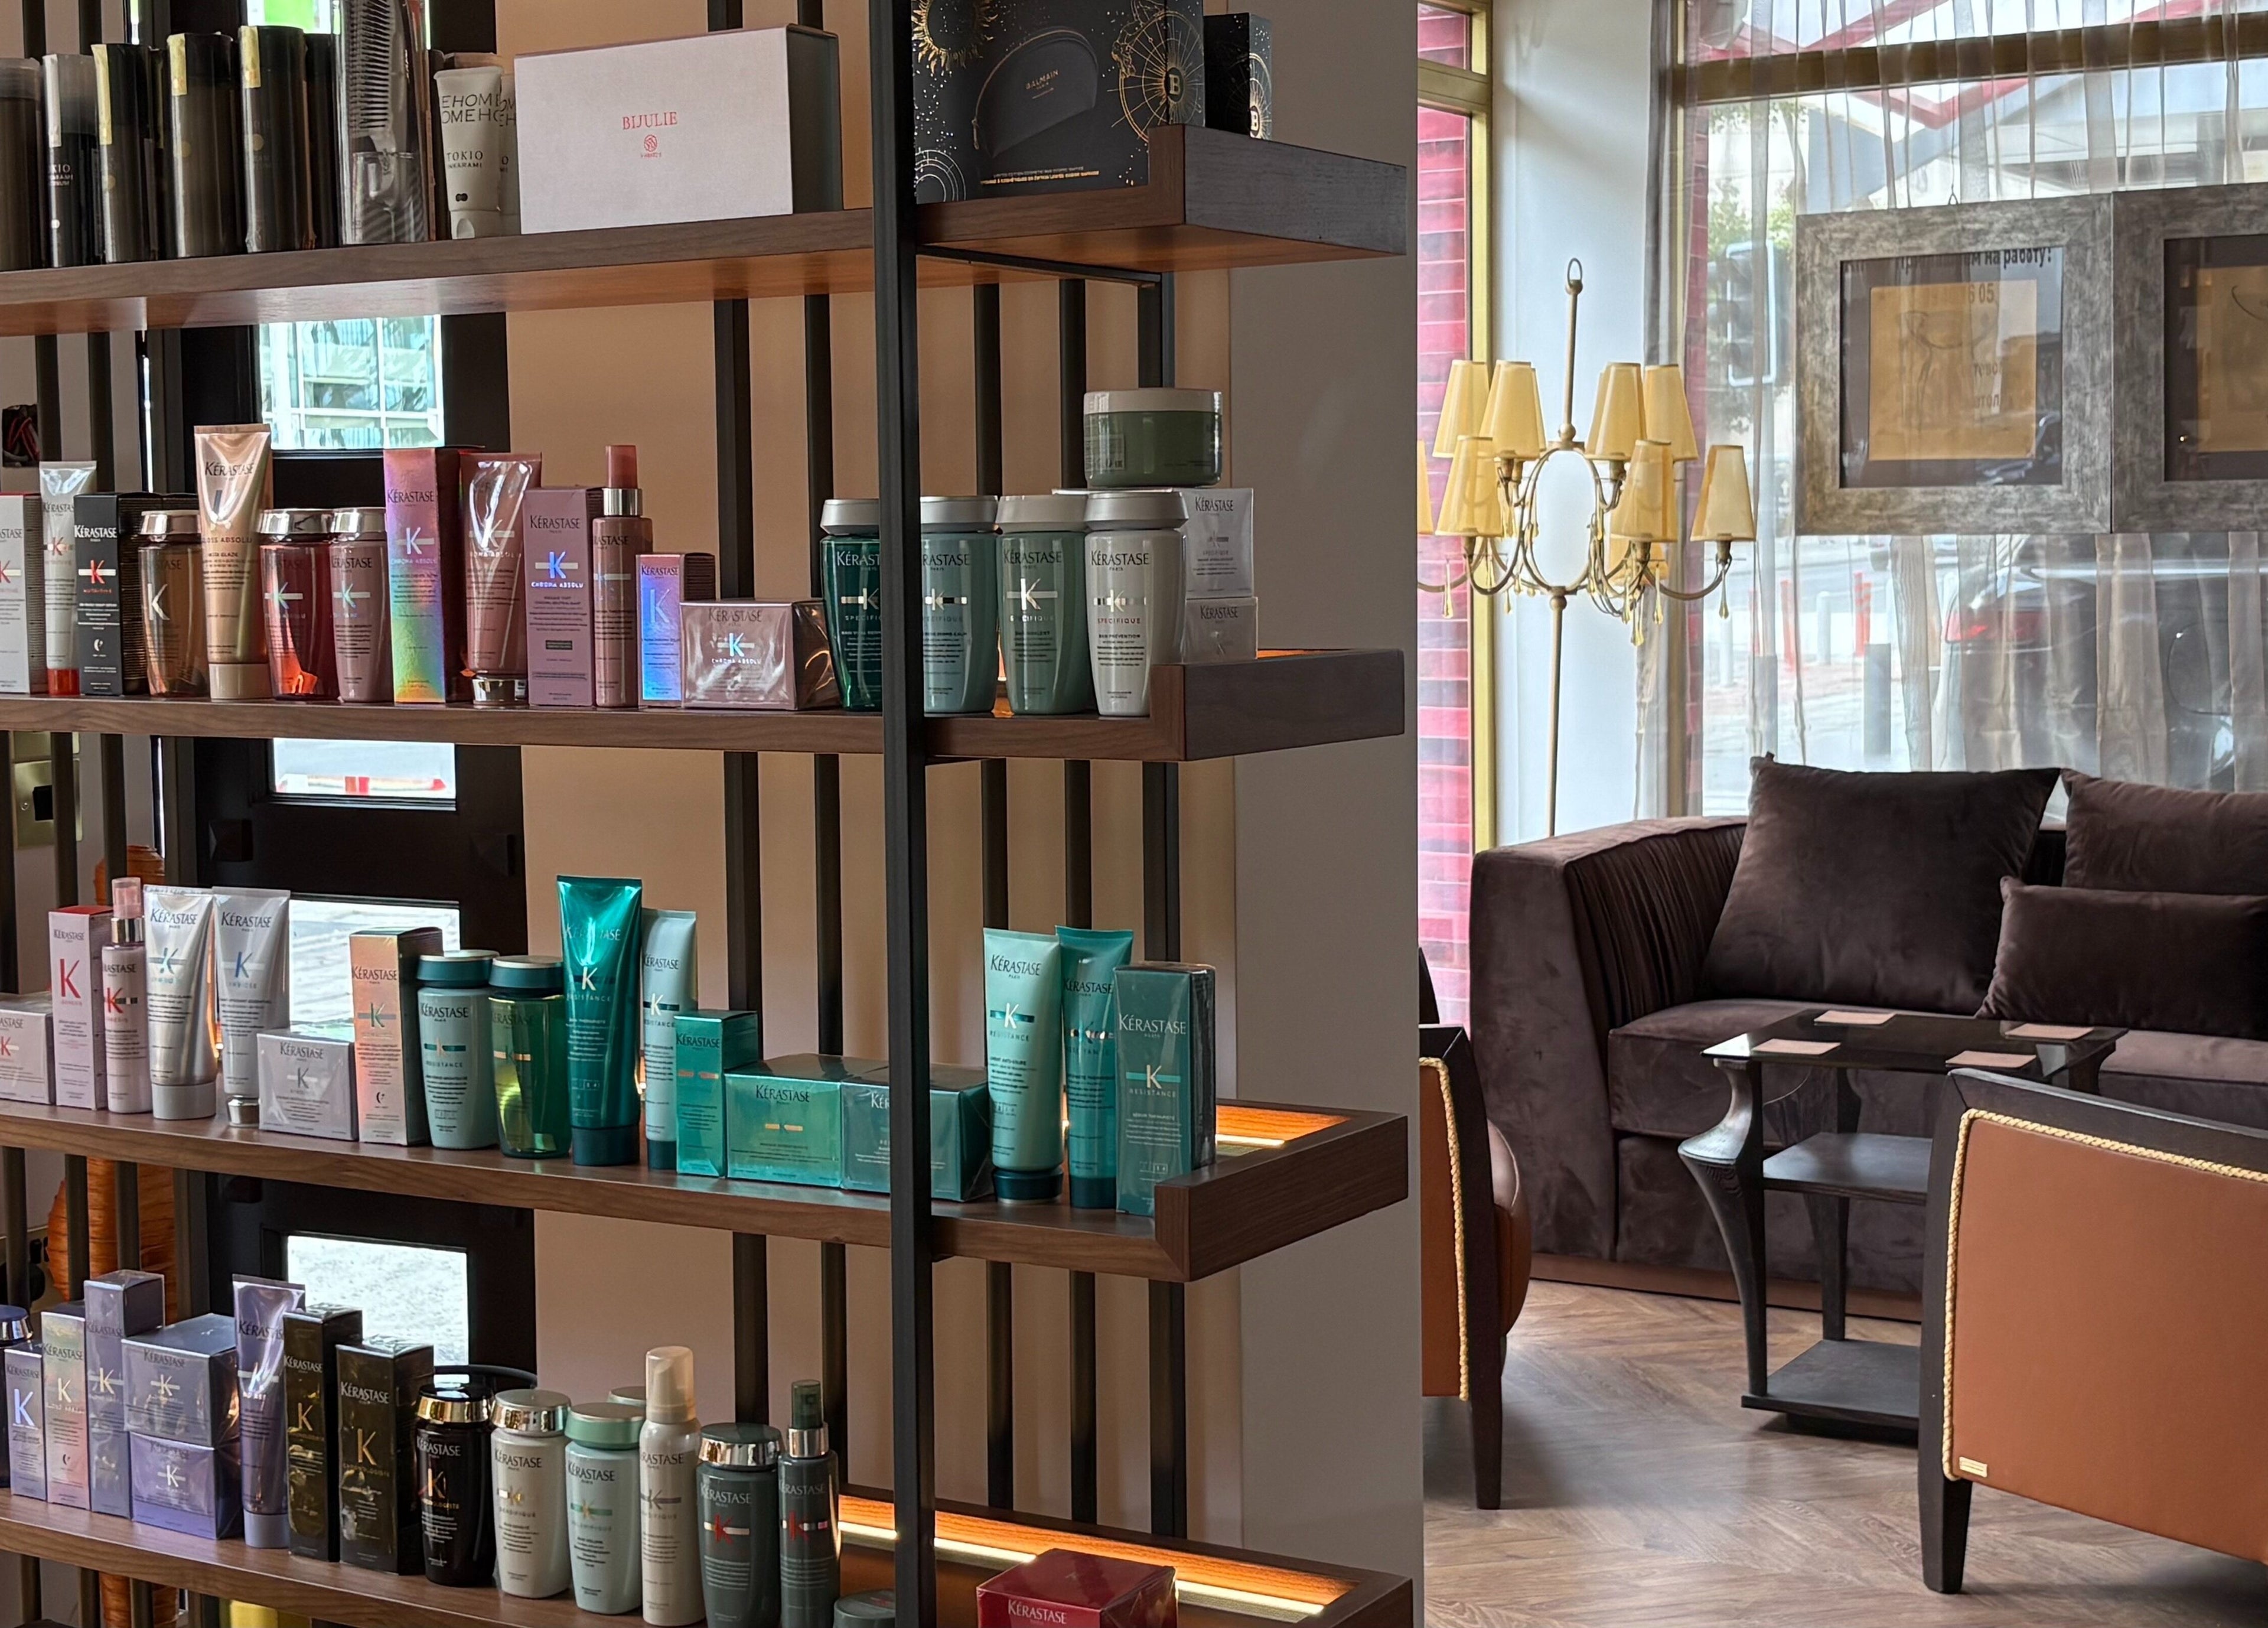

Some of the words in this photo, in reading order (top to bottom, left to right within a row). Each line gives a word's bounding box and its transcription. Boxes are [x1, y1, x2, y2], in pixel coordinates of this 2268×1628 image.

[1025, 69, 1059, 89] BALMAIN
[1169, 74, 1180, 95] B
[623, 112, 677, 129] BIJULIE
[1250, 110, 1259, 131] B
[447, 150, 483, 162] TOKIO
[387, 489, 435, 503] KÉRASTASE
[1195, 496, 1234, 512] KÉRASTASE
[74, 524, 118, 538] KÉRASTASE
[530, 515, 580, 529] KÉRASTASE
[406, 527, 422, 555] K
[549, 551, 567, 579] K
[837, 551, 880, 566] KÉRAST
[922, 553, 970, 566] RASTASE
[1004, 550, 1062, 565] KÉRASTASE
[1091, 550, 1151, 565] KÉRASTASE
[90, 559, 105, 584] K
[641, 565, 679, 576] KÉRASTASE
[1021, 578, 1041, 611] K
[709, 607, 762, 623] KÉRASTASE
[1201, 605, 1239, 620] KÉRASTASE
[729, 632, 745, 657] K
[151, 908, 197, 925] KÉRASTASE
[221, 911, 272, 928] KÉRASTASE
[235, 952, 253, 979] K
[353, 966, 397, 981] KÉRASTASE
[990, 955, 1042, 976] KÉRASTASE
[60, 958, 81, 999] K
[582, 966, 598, 991] K
[1064, 978, 1113, 995] KÉRASTASE
[107, 987, 123, 1014] K
[421, 1003, 469, 1018] KÉRASTASE
[651, 993, 664, 1015] K
[1004, 1002, 1019, 1029] K
[1119, 1014, 1187, 1035] KÉRASTASE
[281, 1041, 324, 1060] KÉRASTASE
[676, 1033, 720, 1049] KÉRASTASE
[298, 1067, 310, 1089] K
[1146, 1064, 1162, 1089] K
[756, 1085, 810, 1102] KÉRASTASE
[284, 1355, 323, 1373] KÉRASTASE
[58, 1378, 71, 1404] K
[341, 1381, 389, 1404] KÉRASTASE
[14, 1388, 35, 1427] K
[298, 1402, 313, 1431] K
[357, 1428, 377, 1466] K
[495, 1449, 543, 1469] KÉRASTASE
[641, 1452, 685, 1465] RASTASE
[568, 1460, 615, 1482] KÉRASTASE
[700, 1483, 752, 1504] KÉRASTASE
[1008, 1598, 1067, 1625] KÉRASTASE
